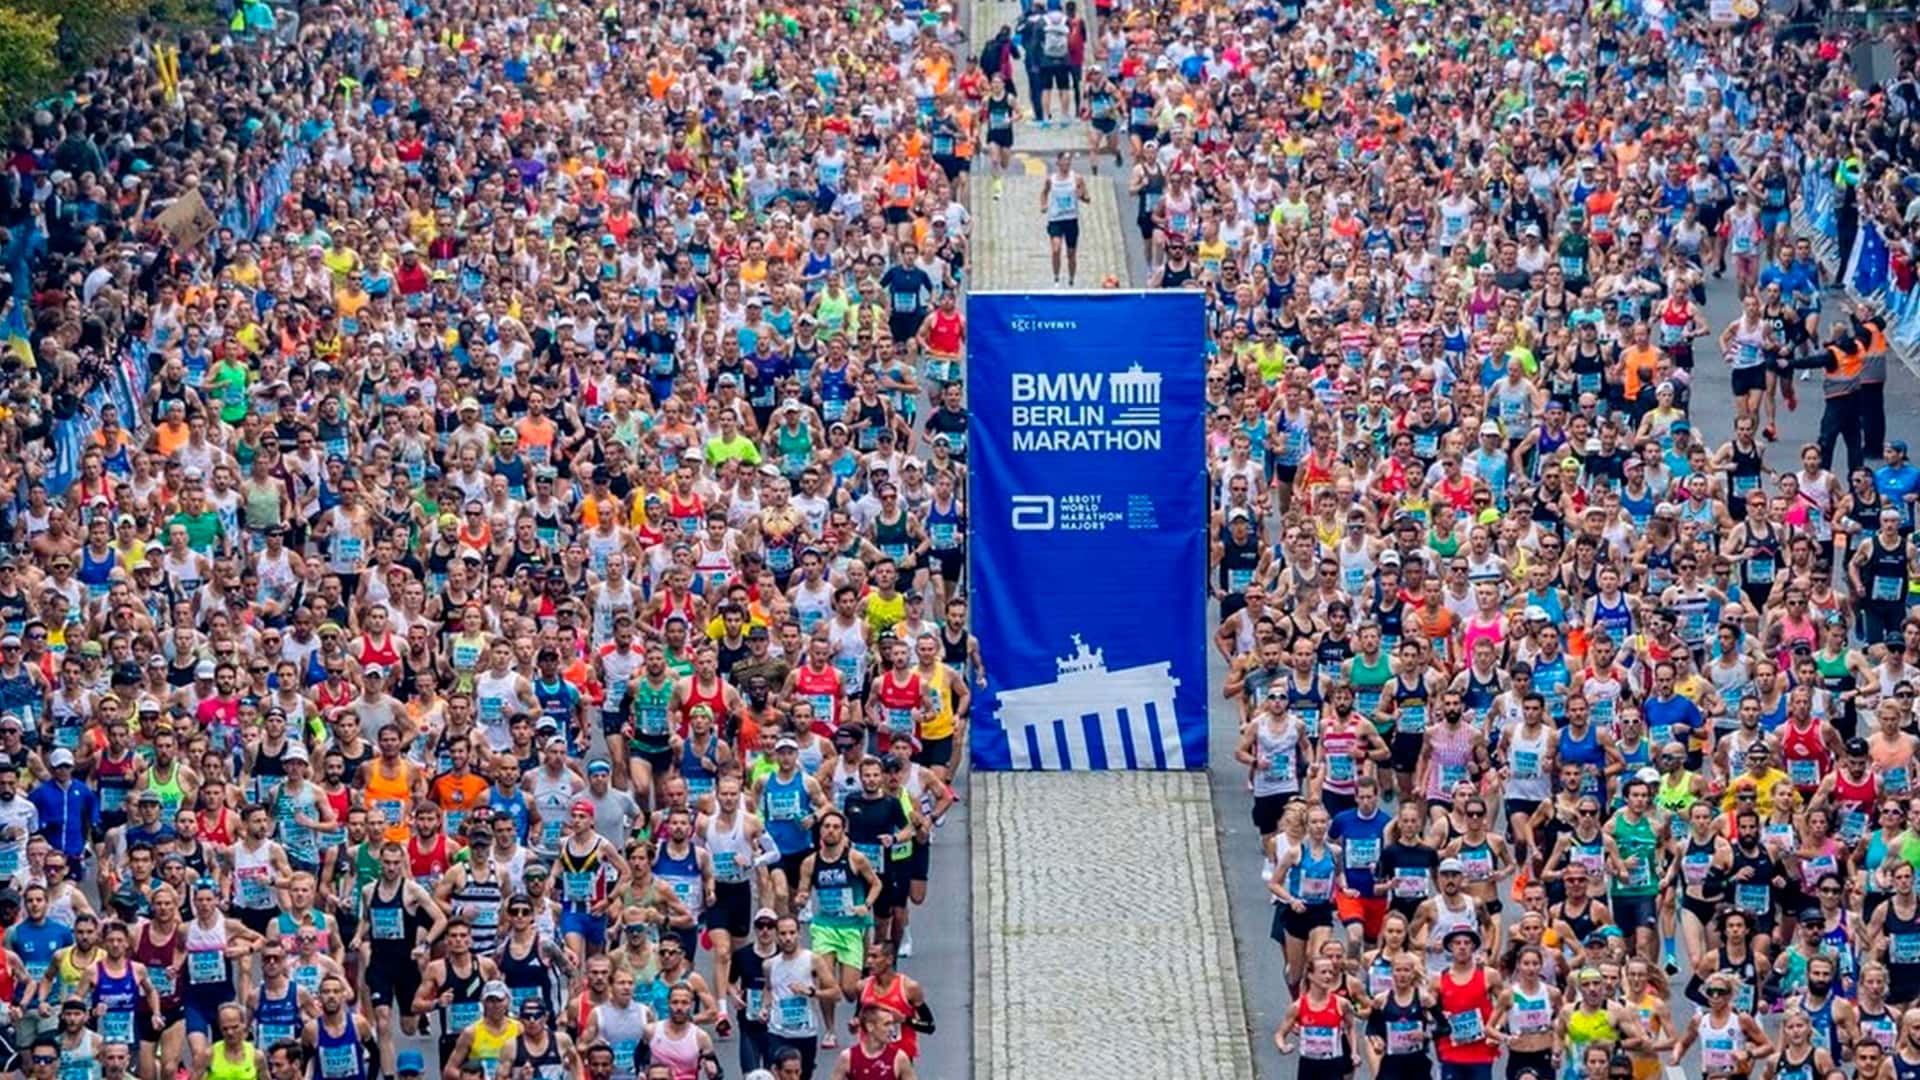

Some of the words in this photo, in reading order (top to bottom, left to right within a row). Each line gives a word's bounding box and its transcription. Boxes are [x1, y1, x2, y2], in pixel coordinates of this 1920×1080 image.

[1037, 321, 1077, 330] EVENTS
[1012, 373, 1103, 402] BMW
[1012, 406, 1105, 427] BERLIN
[1012, 429, 1162, 451] MARATHON
[1060, 495, 1102, 504] ABBOTT
[1060, 504, 1098, 512] WORLD
[1060, 513, 1124, 521] MARATHON
[1060, 522, 1105, 531] MAJORS
